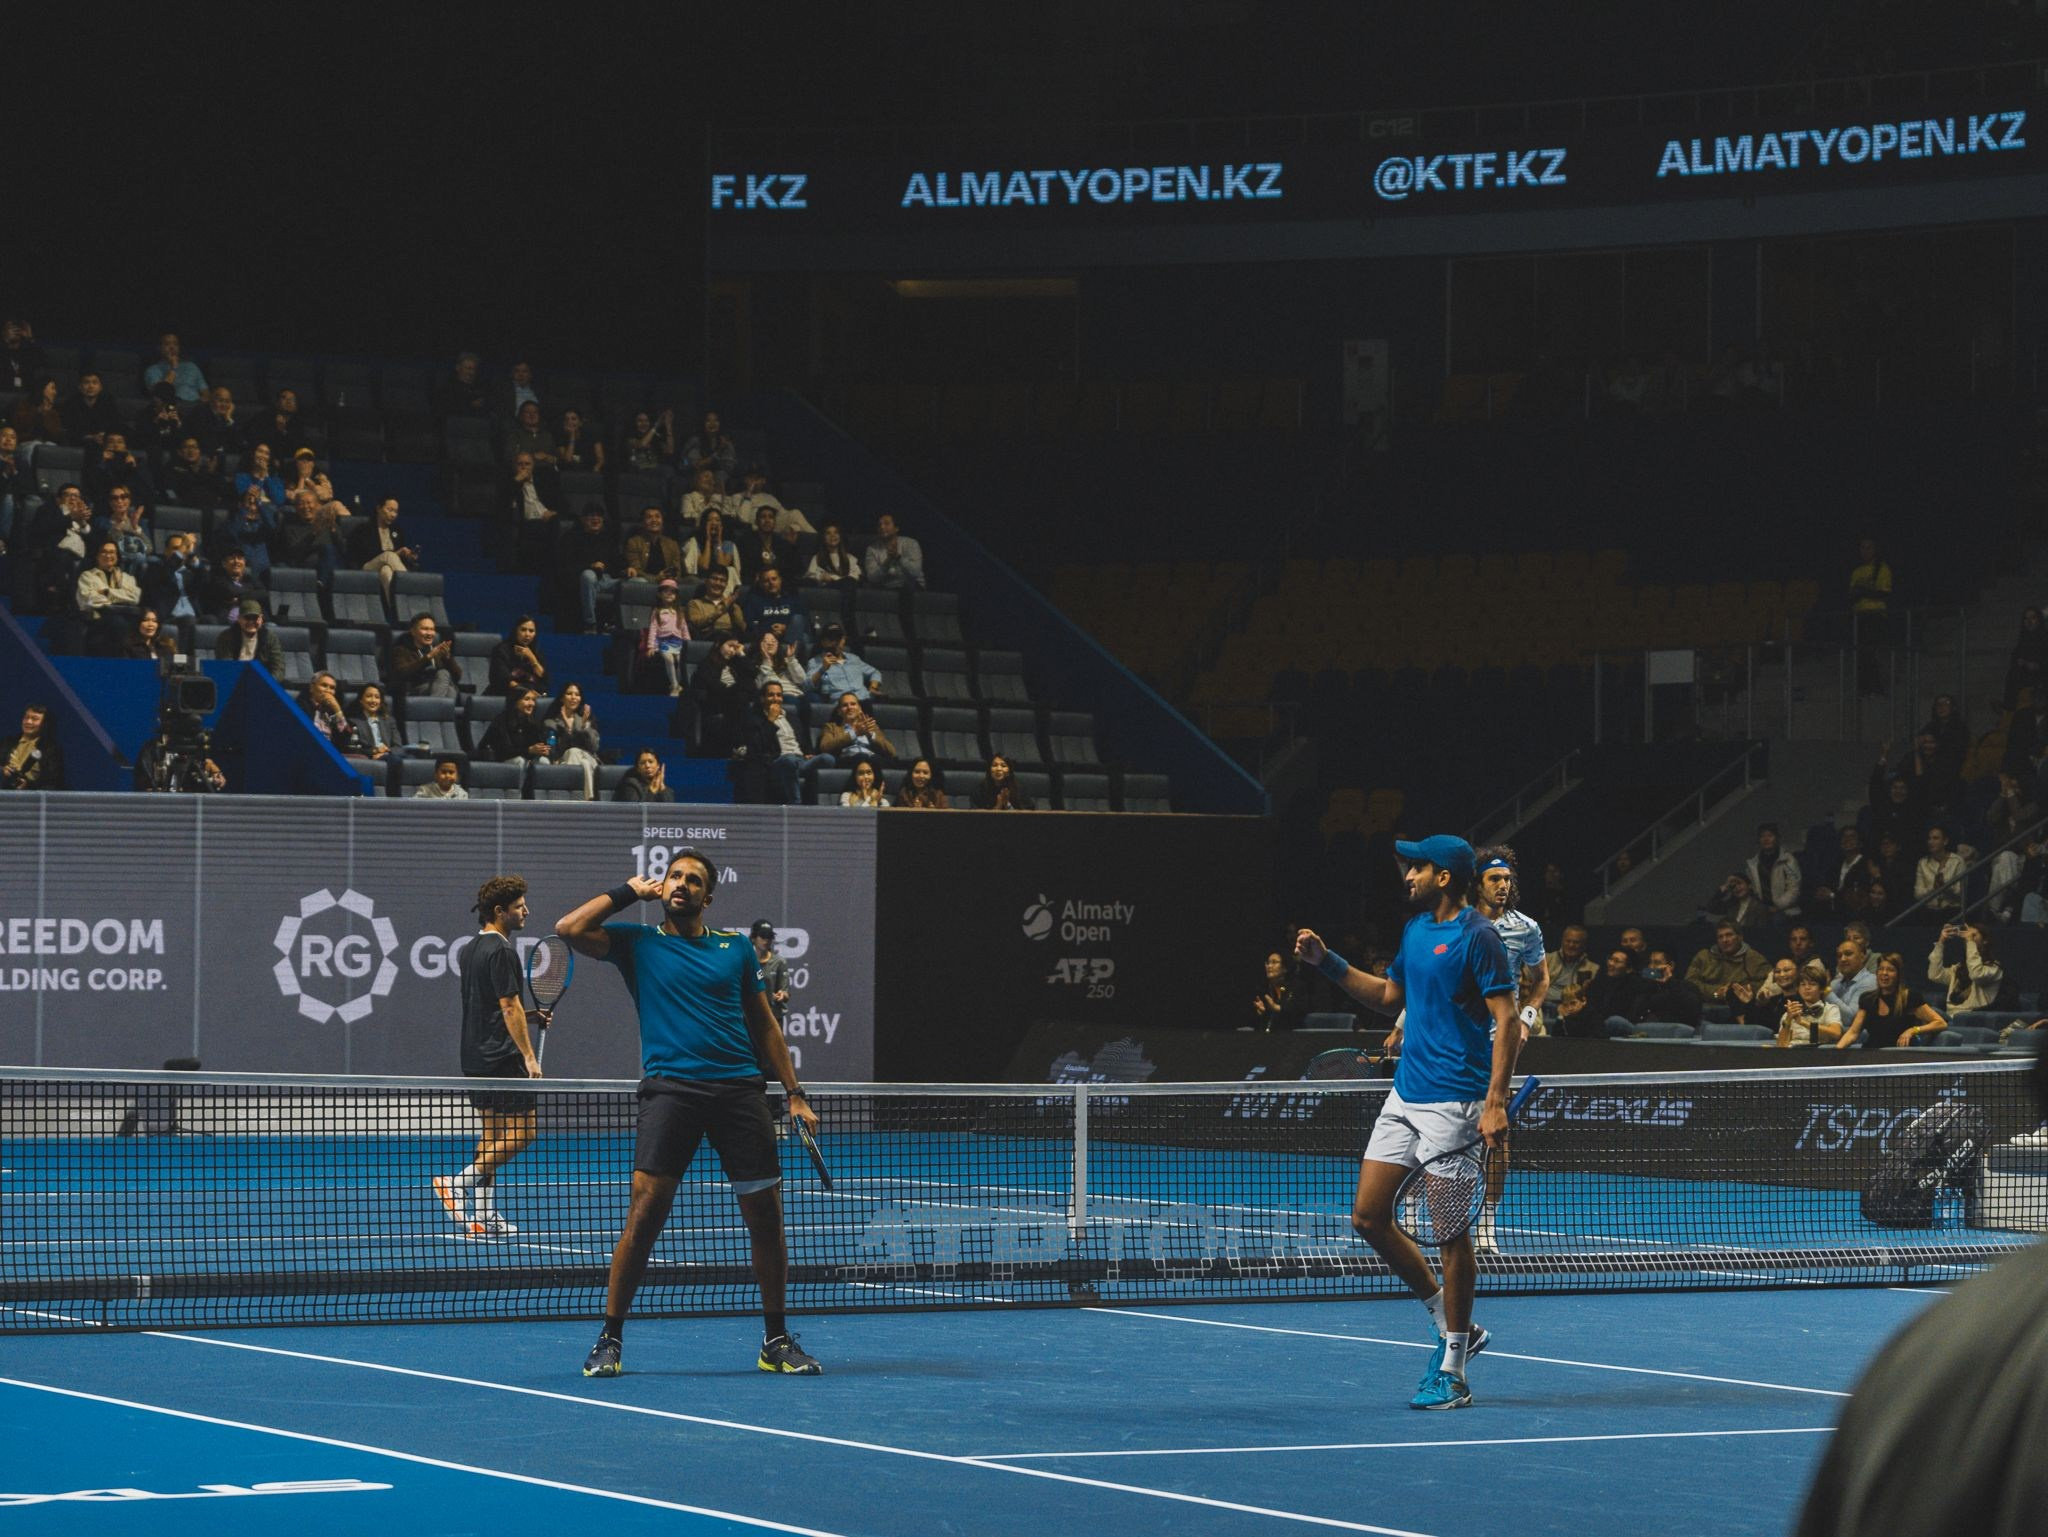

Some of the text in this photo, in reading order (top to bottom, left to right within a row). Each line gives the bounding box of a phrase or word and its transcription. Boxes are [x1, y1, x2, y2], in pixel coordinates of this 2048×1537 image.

[1656, 110, 2027, 179] ALMATYOPEN.KZ
[711, 174, 808, 209] F.KZ
[901, 163, 1283, 208] ALMATYOPEN.KZ
[1373, 147, 1568, 201] @KTF.KZ
[643, 827, 727, 840] SPEED SERVE
[631, 845, 694, 882] 18
[1061, 899, 1136, 927] Almaty
[0, 918, 165, 955] EEDOM
[1060, 921, 1112, 946] Open
[302, 935, 372, 978] RG
[410, 935, 551, 979] GD
[1046, 957, 1116, 985] ATP
[87, 968, 168, 991] CORP.
[1086, 984, 1116, 999] 250
